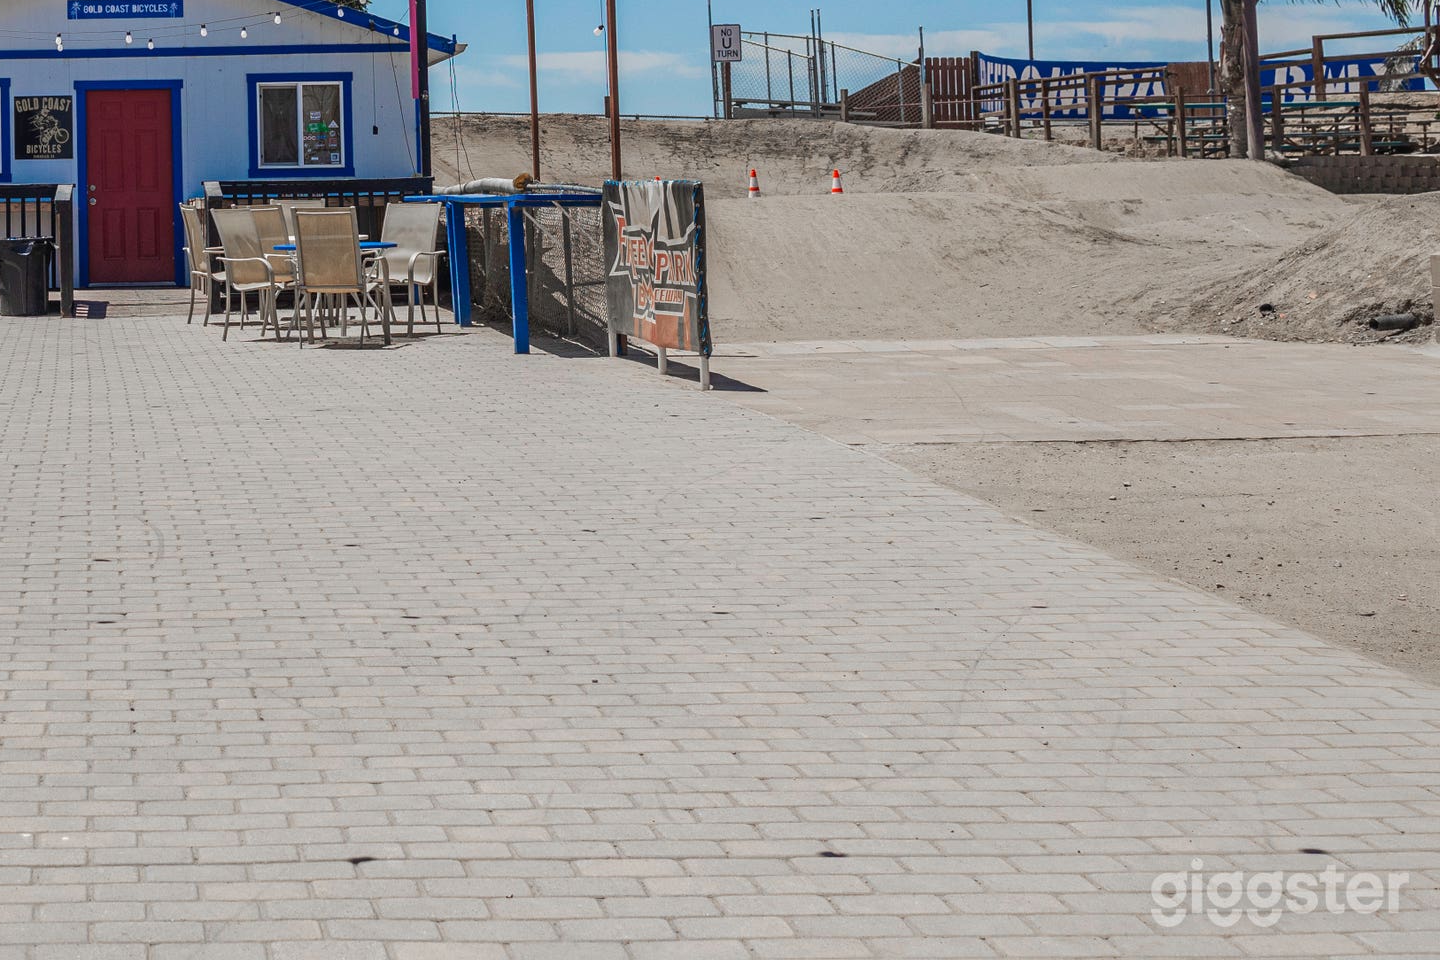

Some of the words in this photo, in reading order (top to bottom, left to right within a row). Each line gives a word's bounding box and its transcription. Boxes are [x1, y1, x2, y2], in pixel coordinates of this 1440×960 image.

[83, 4, 103, 14] GOLD
[105, 4, 130, 14] COAST
[131, 3, 168, 13] BICYCLES
[720, 28, 733, 37] NO
[722, 37, 732, 49] U
[716, 49, 739, 58] TURN
[15, 97, 40, 113] GOLD
[42, 97, 72, 112] COAST
[26, 144, 62, 154] BICYCLES
